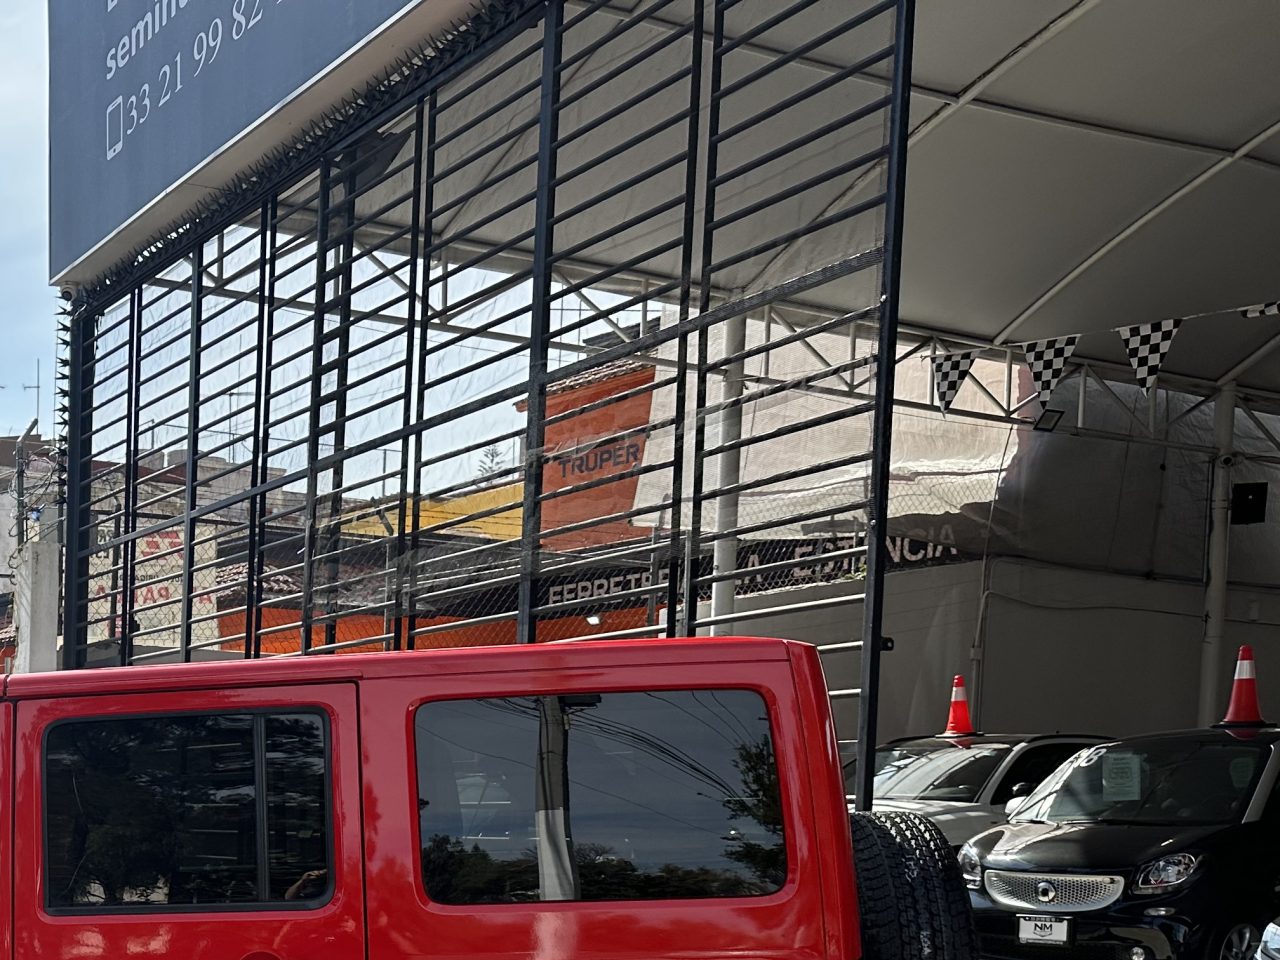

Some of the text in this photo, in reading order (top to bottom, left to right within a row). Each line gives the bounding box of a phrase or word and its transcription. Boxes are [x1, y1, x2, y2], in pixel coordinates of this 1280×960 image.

[106, 0, 192, 80] semin
[126, 83, 150, 135] 33
[158, 51, 183, 107] 21
[193, 17, 222, 78] 99
[557, 442, 640, 478] TRUPER
[1034, 922, 1053, 931] NM
